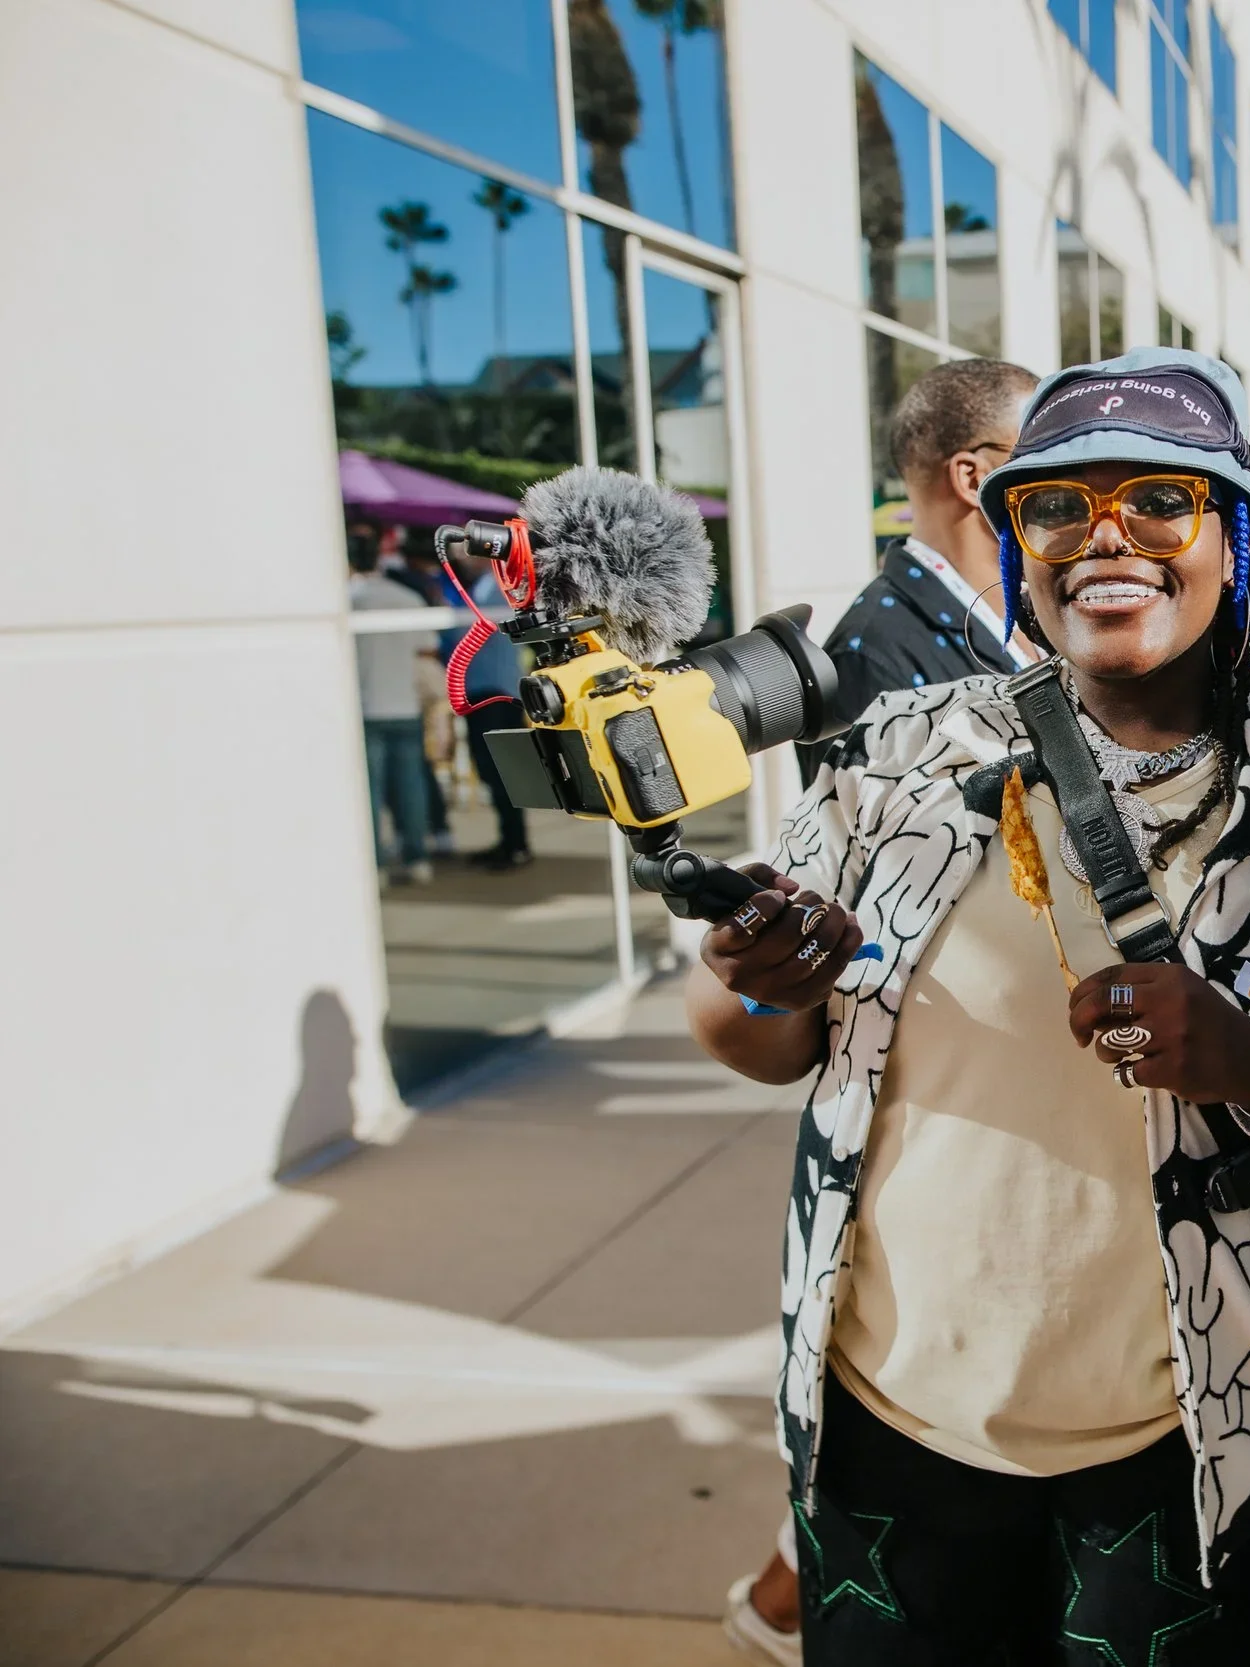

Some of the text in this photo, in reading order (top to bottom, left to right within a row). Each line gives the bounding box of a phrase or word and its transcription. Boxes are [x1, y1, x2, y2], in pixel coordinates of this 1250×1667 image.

[1031, 379, 1213, 427] brb, going horizontal
